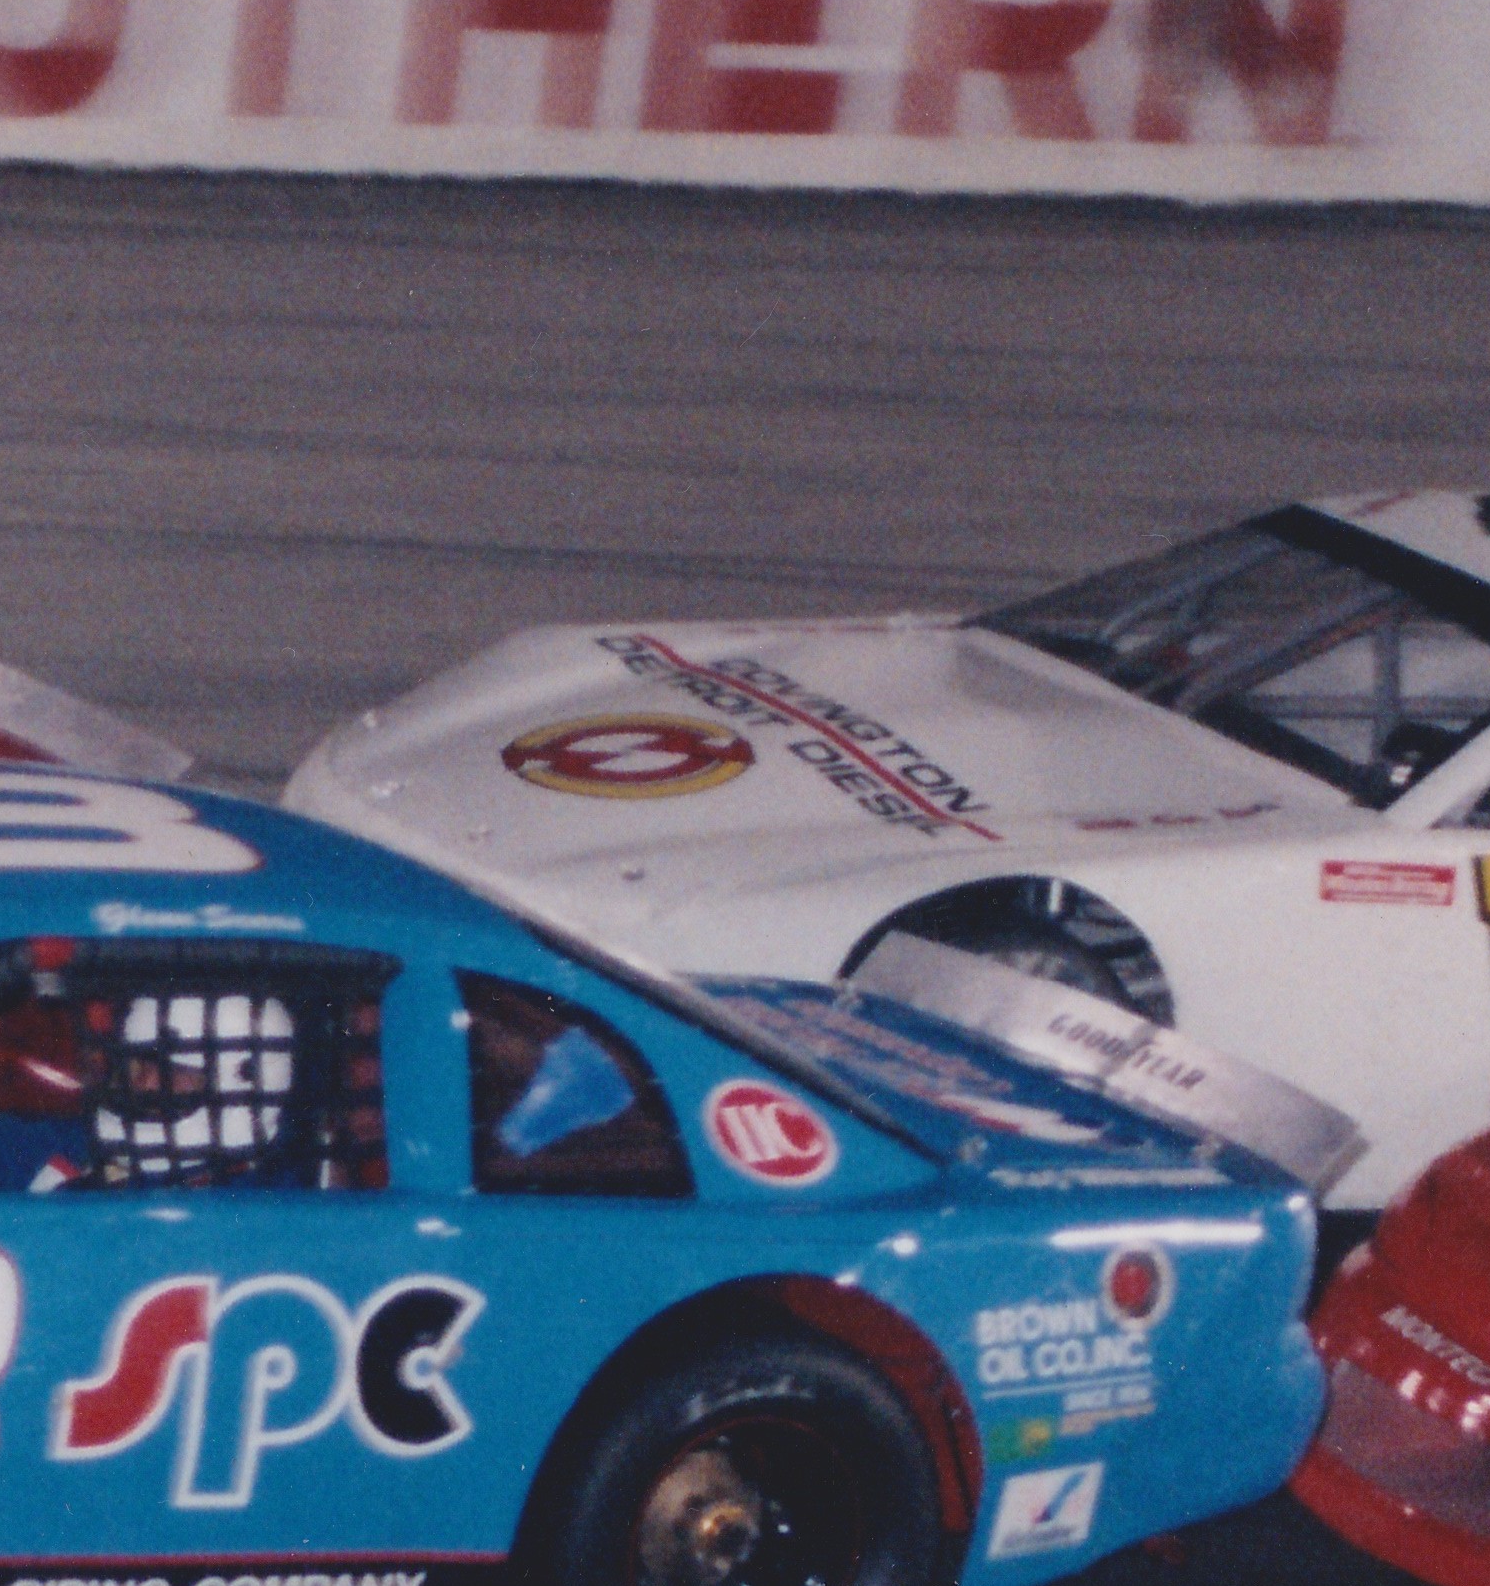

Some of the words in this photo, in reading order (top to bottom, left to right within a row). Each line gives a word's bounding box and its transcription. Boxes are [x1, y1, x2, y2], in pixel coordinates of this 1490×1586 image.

[594, 635, 794, 727] DETROIT
[712, 657, 990, 814] COVINGTON
[976, 1298, 1099, 1347] BROWN
[976, 1346, 1029, 1385] OIL
